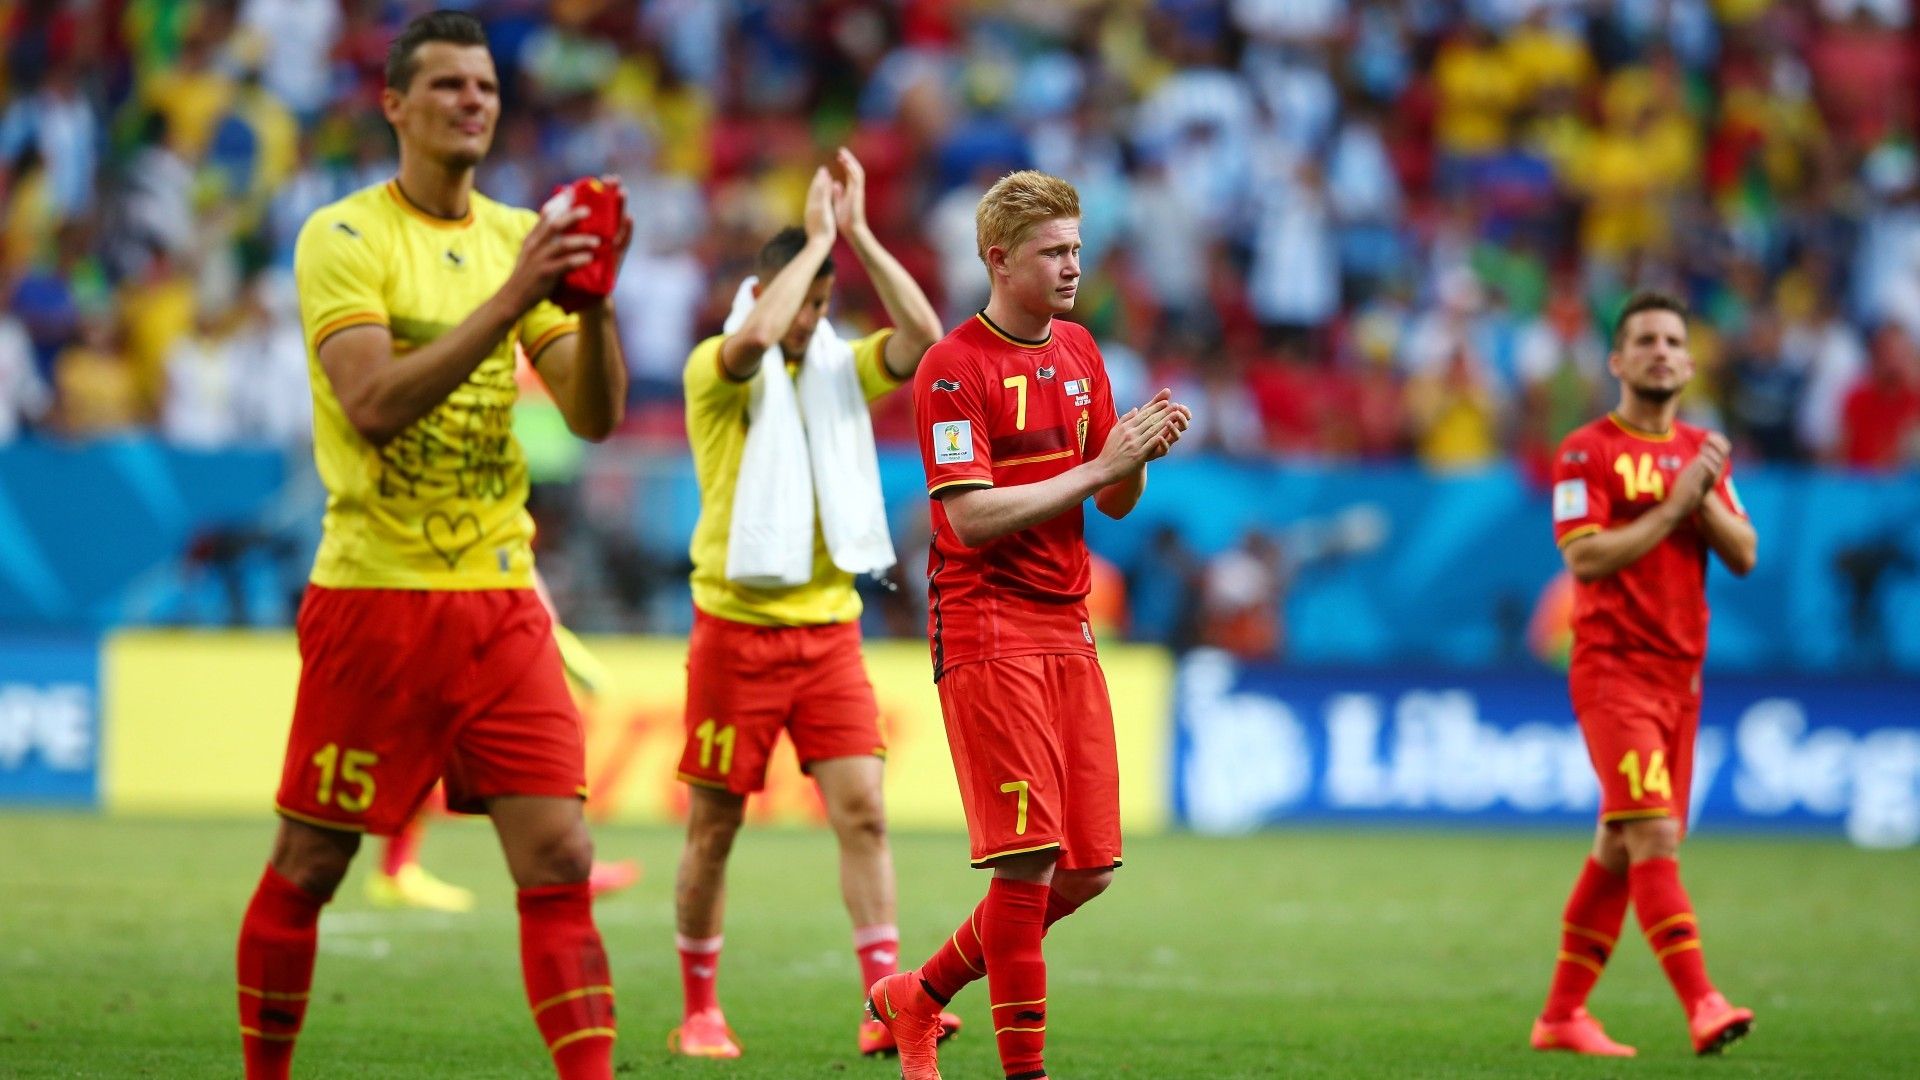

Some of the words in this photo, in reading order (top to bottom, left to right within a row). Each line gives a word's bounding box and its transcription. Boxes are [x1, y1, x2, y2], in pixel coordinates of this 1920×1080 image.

[1003, 375, 1028, 431] 7
[1614, 452, 1664, 500] 14
[696, 720, 735, 773] 11
[1325, 690, 1726, 832] Libery
[313, 743, 377, 813] 15
[1619, 749, 1671, 801] 14
[1000, 780, 1029, 836] 7
